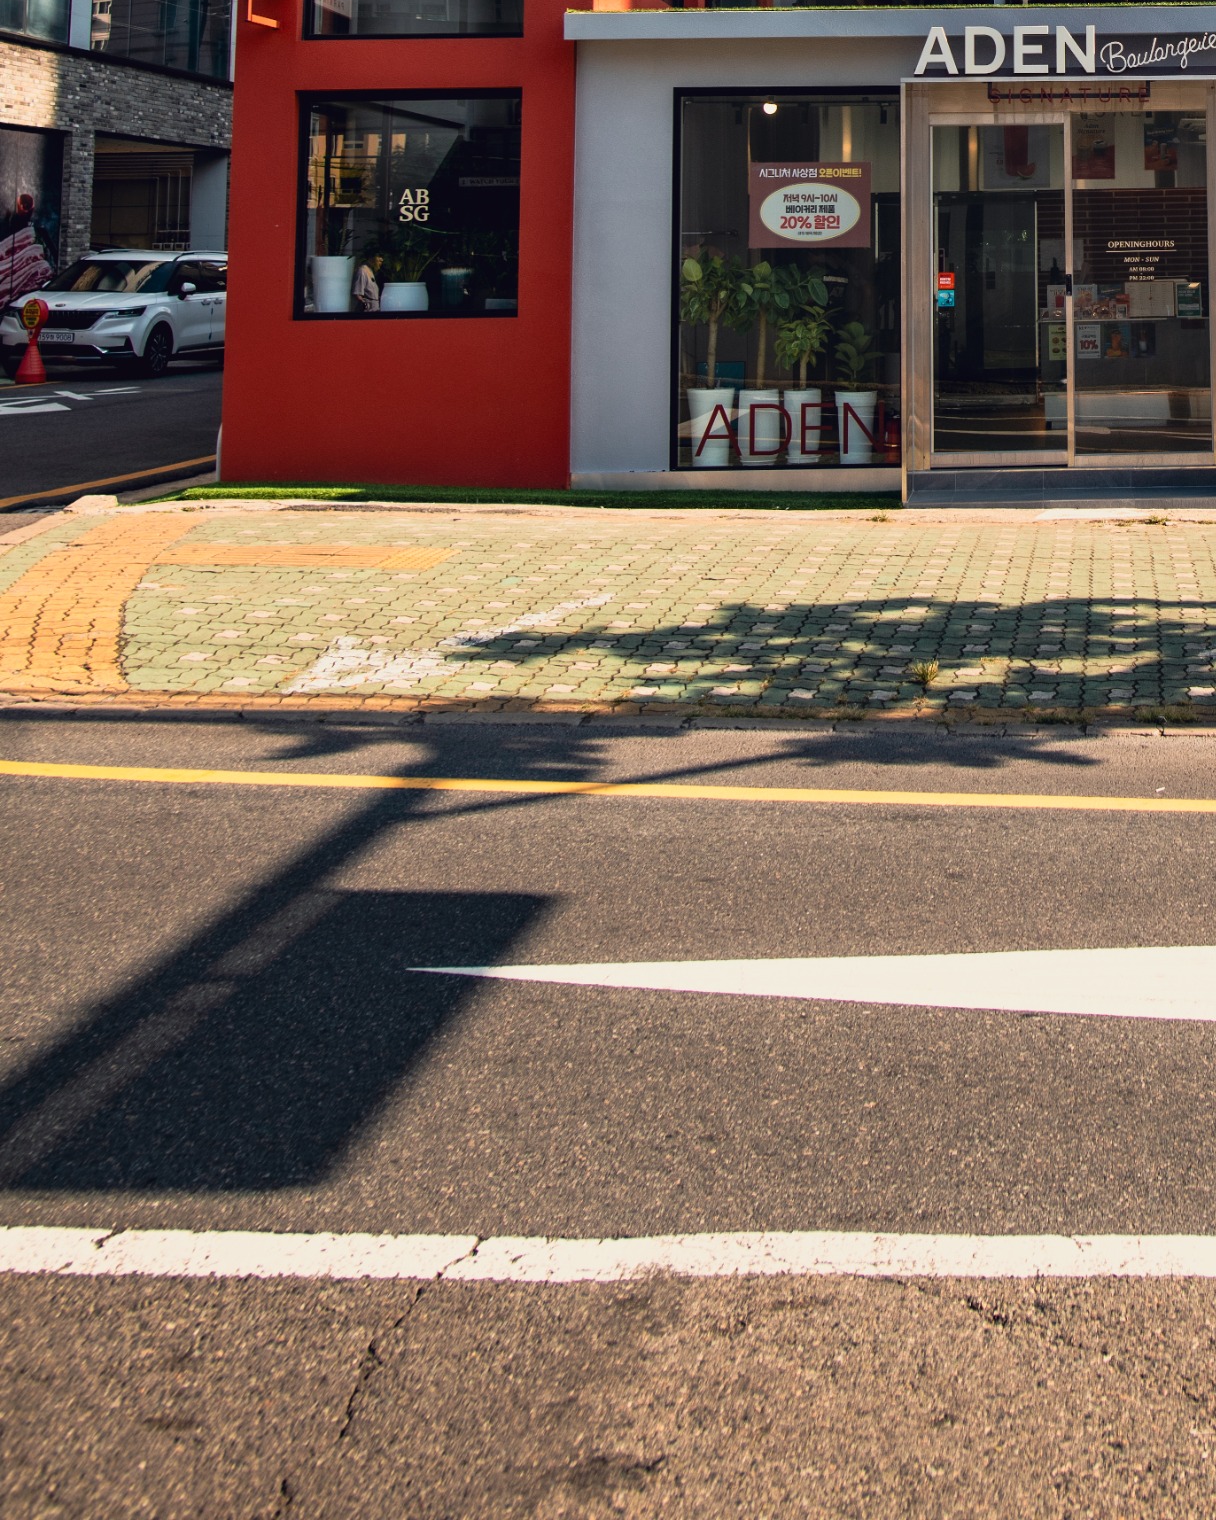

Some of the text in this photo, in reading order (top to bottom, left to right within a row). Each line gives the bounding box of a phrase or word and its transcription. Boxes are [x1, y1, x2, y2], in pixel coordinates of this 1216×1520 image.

[913, 25, 1096, 75] ADEN
[989, 86, 1151, 105] SIGNATURE
[759, 167, 791, 178] 시그니처
[792, 167, 818, 178] 사상점
[398, 188, 430, 205] AB
[783, 193, 800, 203] 저녁
[399, 205, 430, 222] SG
[785, 204, 835, 214] 베이커리 제품
[780, 215, 840, 230] 20% 할인
[694, 399, 886, 457] ADEN
